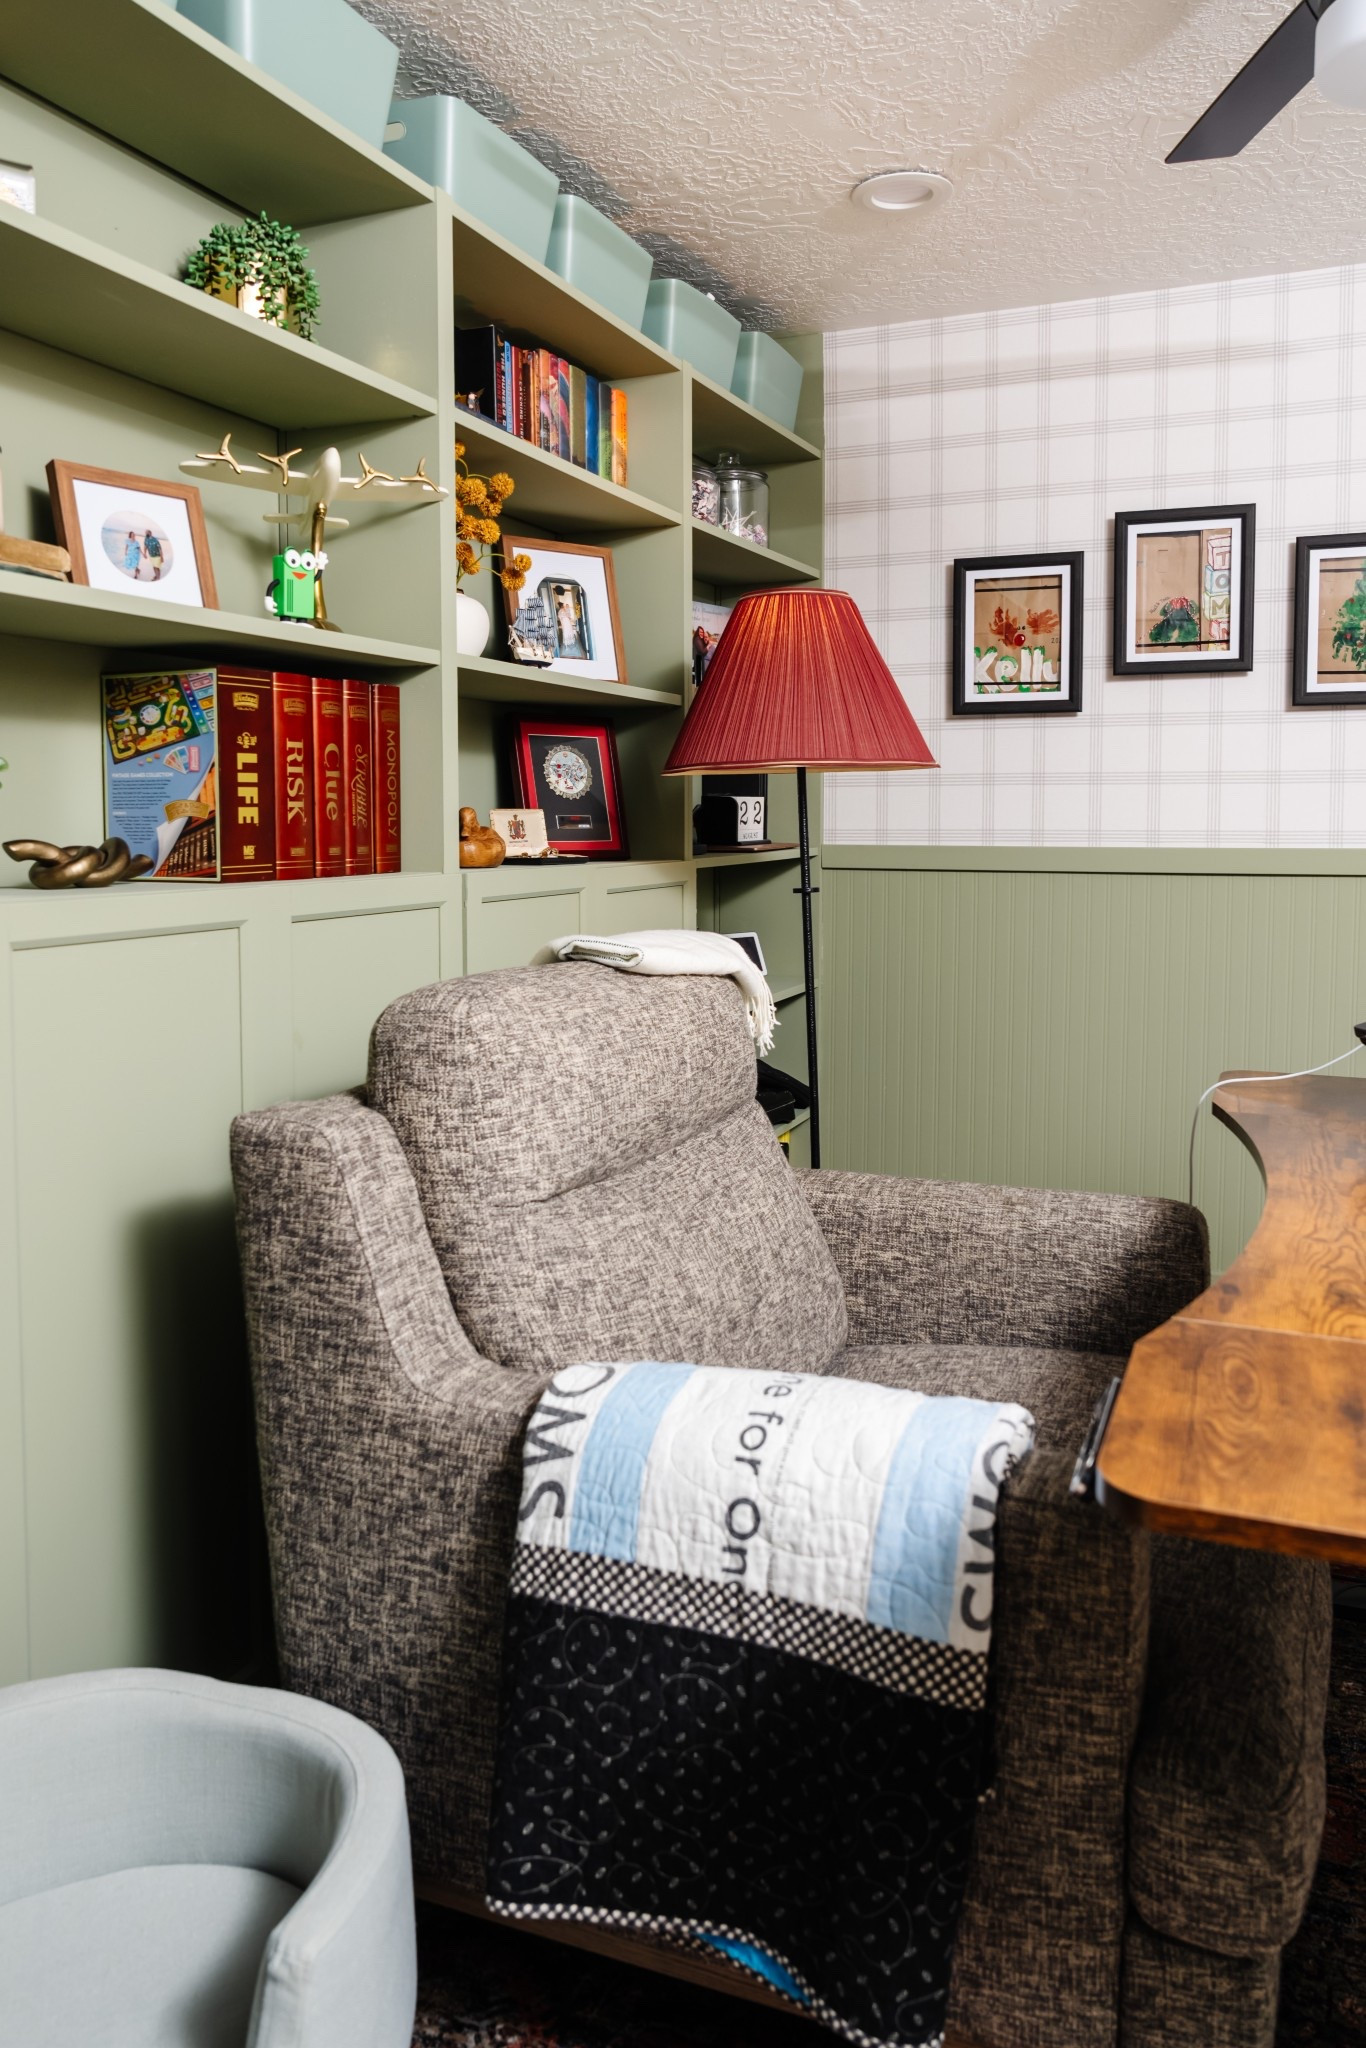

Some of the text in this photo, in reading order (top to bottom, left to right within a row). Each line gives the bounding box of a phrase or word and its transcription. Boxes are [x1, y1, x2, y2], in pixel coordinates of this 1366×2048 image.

[237, 753, 259, 824] LIFE
[286, 738, 305, 824] RISK
[324, 743, 340, 820] Clue
[351, 744, 368, 829] SCRABBLE
[386, 729, 397, 837] MONOPOLY
[734, 1411, 784, 1476] for
